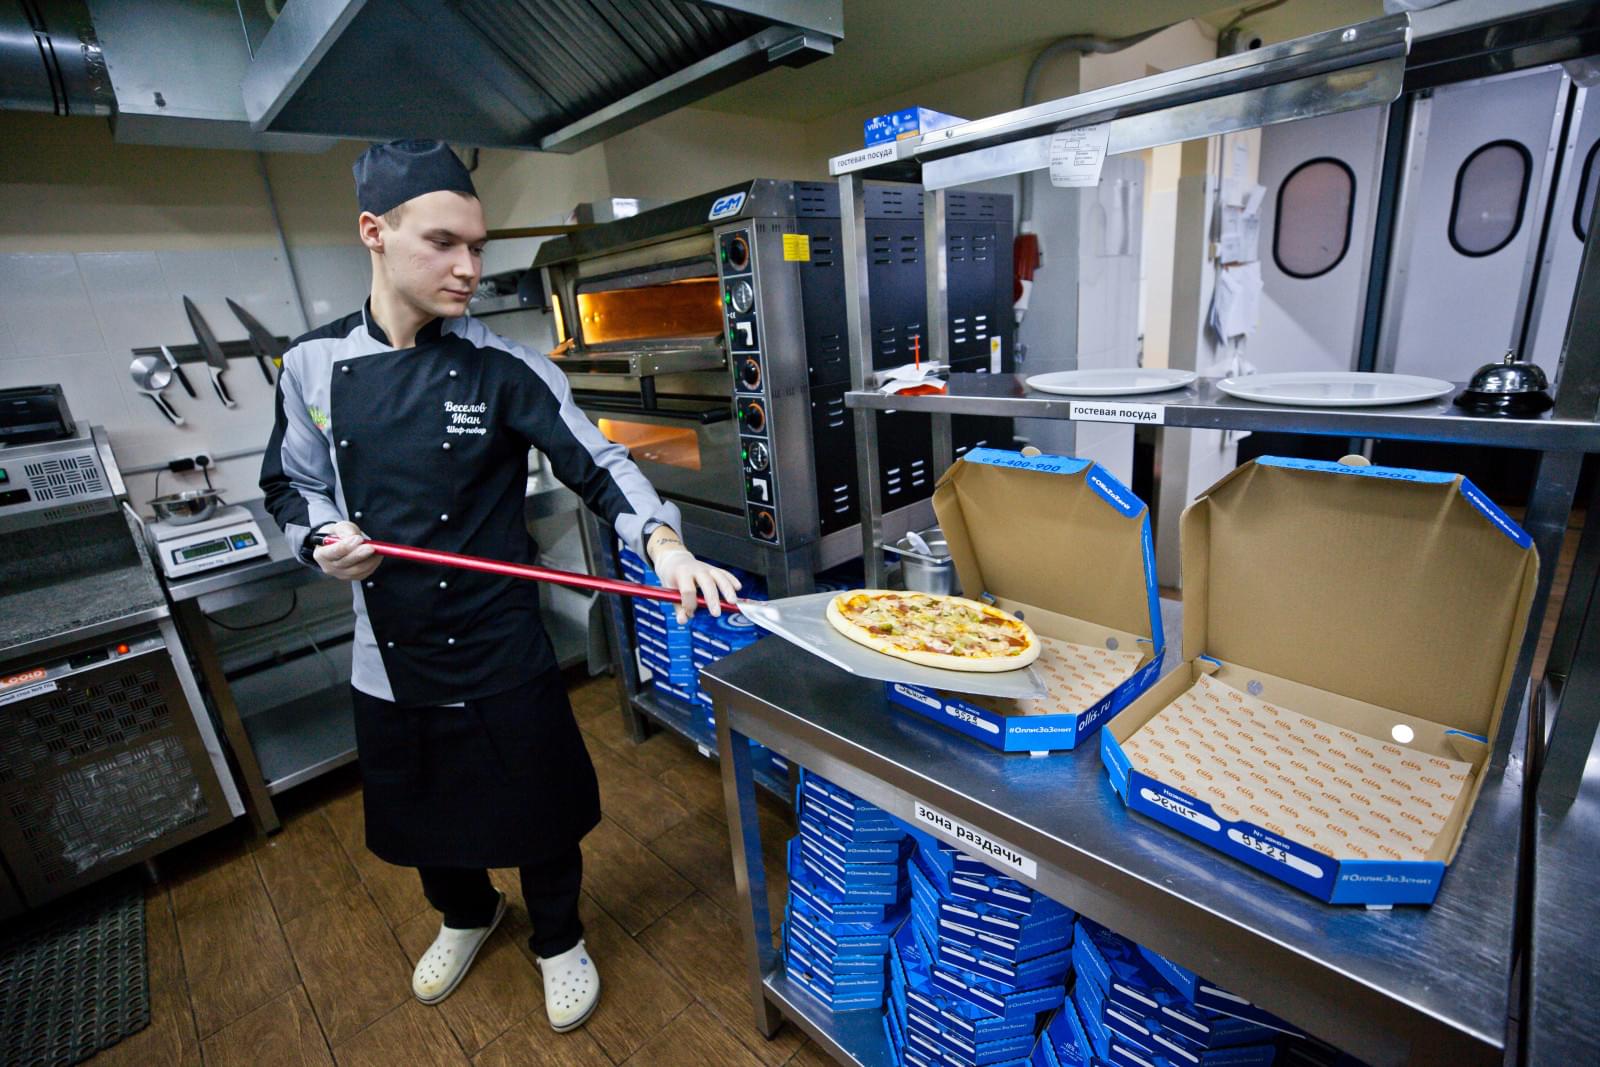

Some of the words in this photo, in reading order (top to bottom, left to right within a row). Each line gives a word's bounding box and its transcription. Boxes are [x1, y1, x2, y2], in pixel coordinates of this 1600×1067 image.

[867, 120, 887, 131] VINYL
[837, 154, 866, 168] гостевая
[867, 148, 893, 160] посуда
[444, 400, 487, 413] Веселов
[1074, 407, 1117, 417] гостевая
[1119, 409, 1157, 420] посуда
[452, 412, 481, 424] Иван
[446, 425, 487, 435] Шеф-повар
[992, 458, 1061, 472] 6-400-900
[1078, 701, 1111, 731] ollis.ru
[1151, 791, 1198, 818] Зенит
[919, 806, 952, 830] зона
[956, 825, 1022, 866] раздачи
[1242, 832, 1287, 863] 9529
